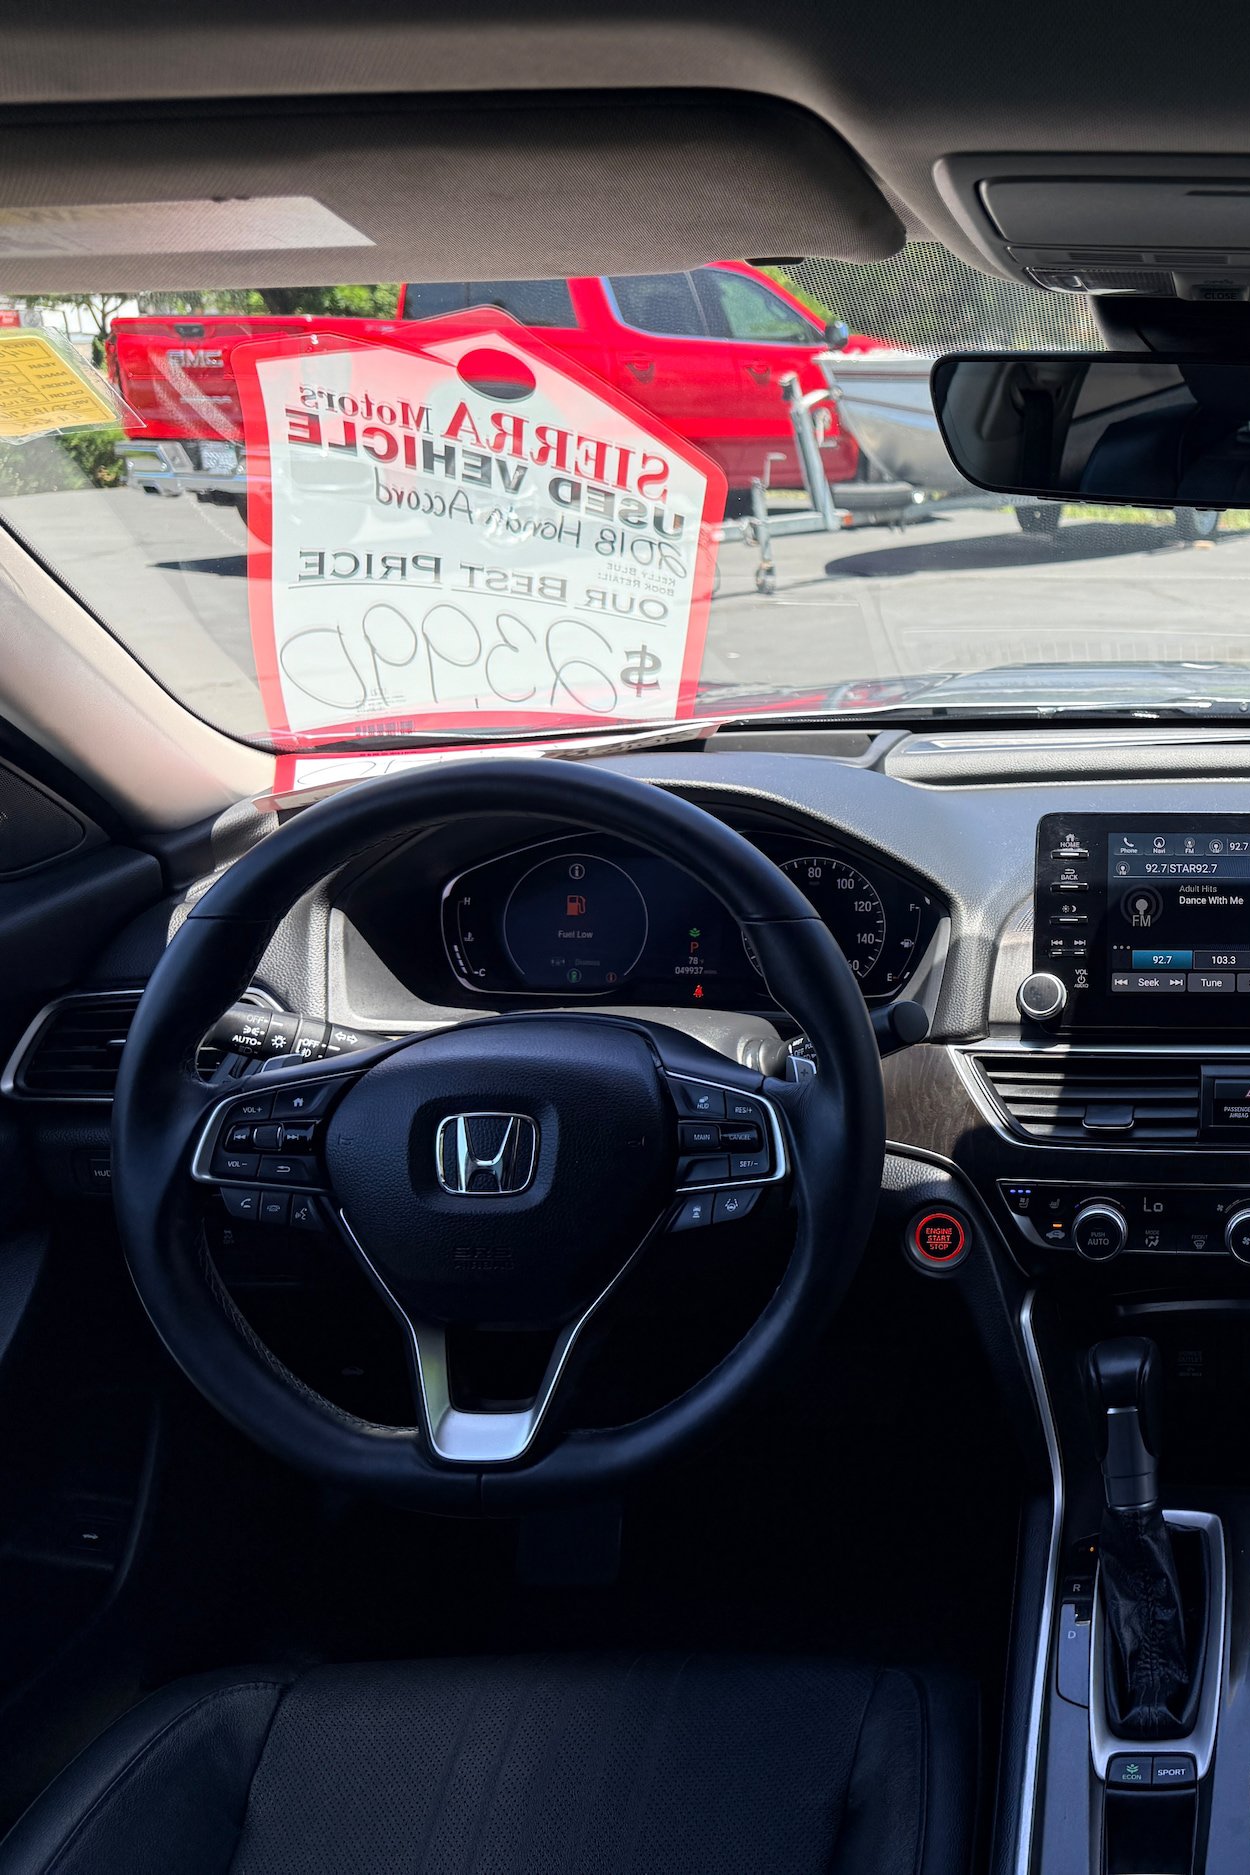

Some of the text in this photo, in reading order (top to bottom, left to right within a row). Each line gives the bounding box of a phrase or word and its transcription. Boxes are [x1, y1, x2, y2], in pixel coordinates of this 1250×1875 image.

[1204, 292, 1237, 300] CLOSE
[166, 349, 225, 369] GMC
[1120, 846, 1138, 854] Phone
[1230, 842, 1249, 851] 92.7
[808, 867, 821, 878] 80
[837, 878, 854, 889] 100
[1179, 884, 1218, 893] Adult Hits
[464, 897, 470, 905] H
[1179, 896, 1244, 905] Dance With Me
[854, 901, 872, 912] 120
[1132, 914, 1151, 927] FM
[558, 930, 593, 939] Fuel Low
[857, 933, 874, 944] 140
[691, 942, 699, 953] P
[688, 957, 699, 965] 78
[1152, 955, 1172, 964] 92.7
[1211, 956, 1236, 965] 103.3
[478, 968, 486, 977] C
[675, 967, 704, 975] 049937
[887, 973, 893, 981] E
[1138, 978, 1160, 987] Seek
[1201, 979, 1222, 987] Tune
[246, 1014, 265, 1023] OFF
[232, 1034, 258, 1046] AUTO
[302, 1038, 320, 1048] OFF
[1143, 1197, 1163, 1213] Lo
[925, 1227, 952, 1235] ENGINE
[1087, 1238, 1110, 1246] AUTO
[1072, 1583, 1081, 1592] R
[1068, 1630, 1076, 1639] D
[1157, 1768, 1186, 1776] SPORT
